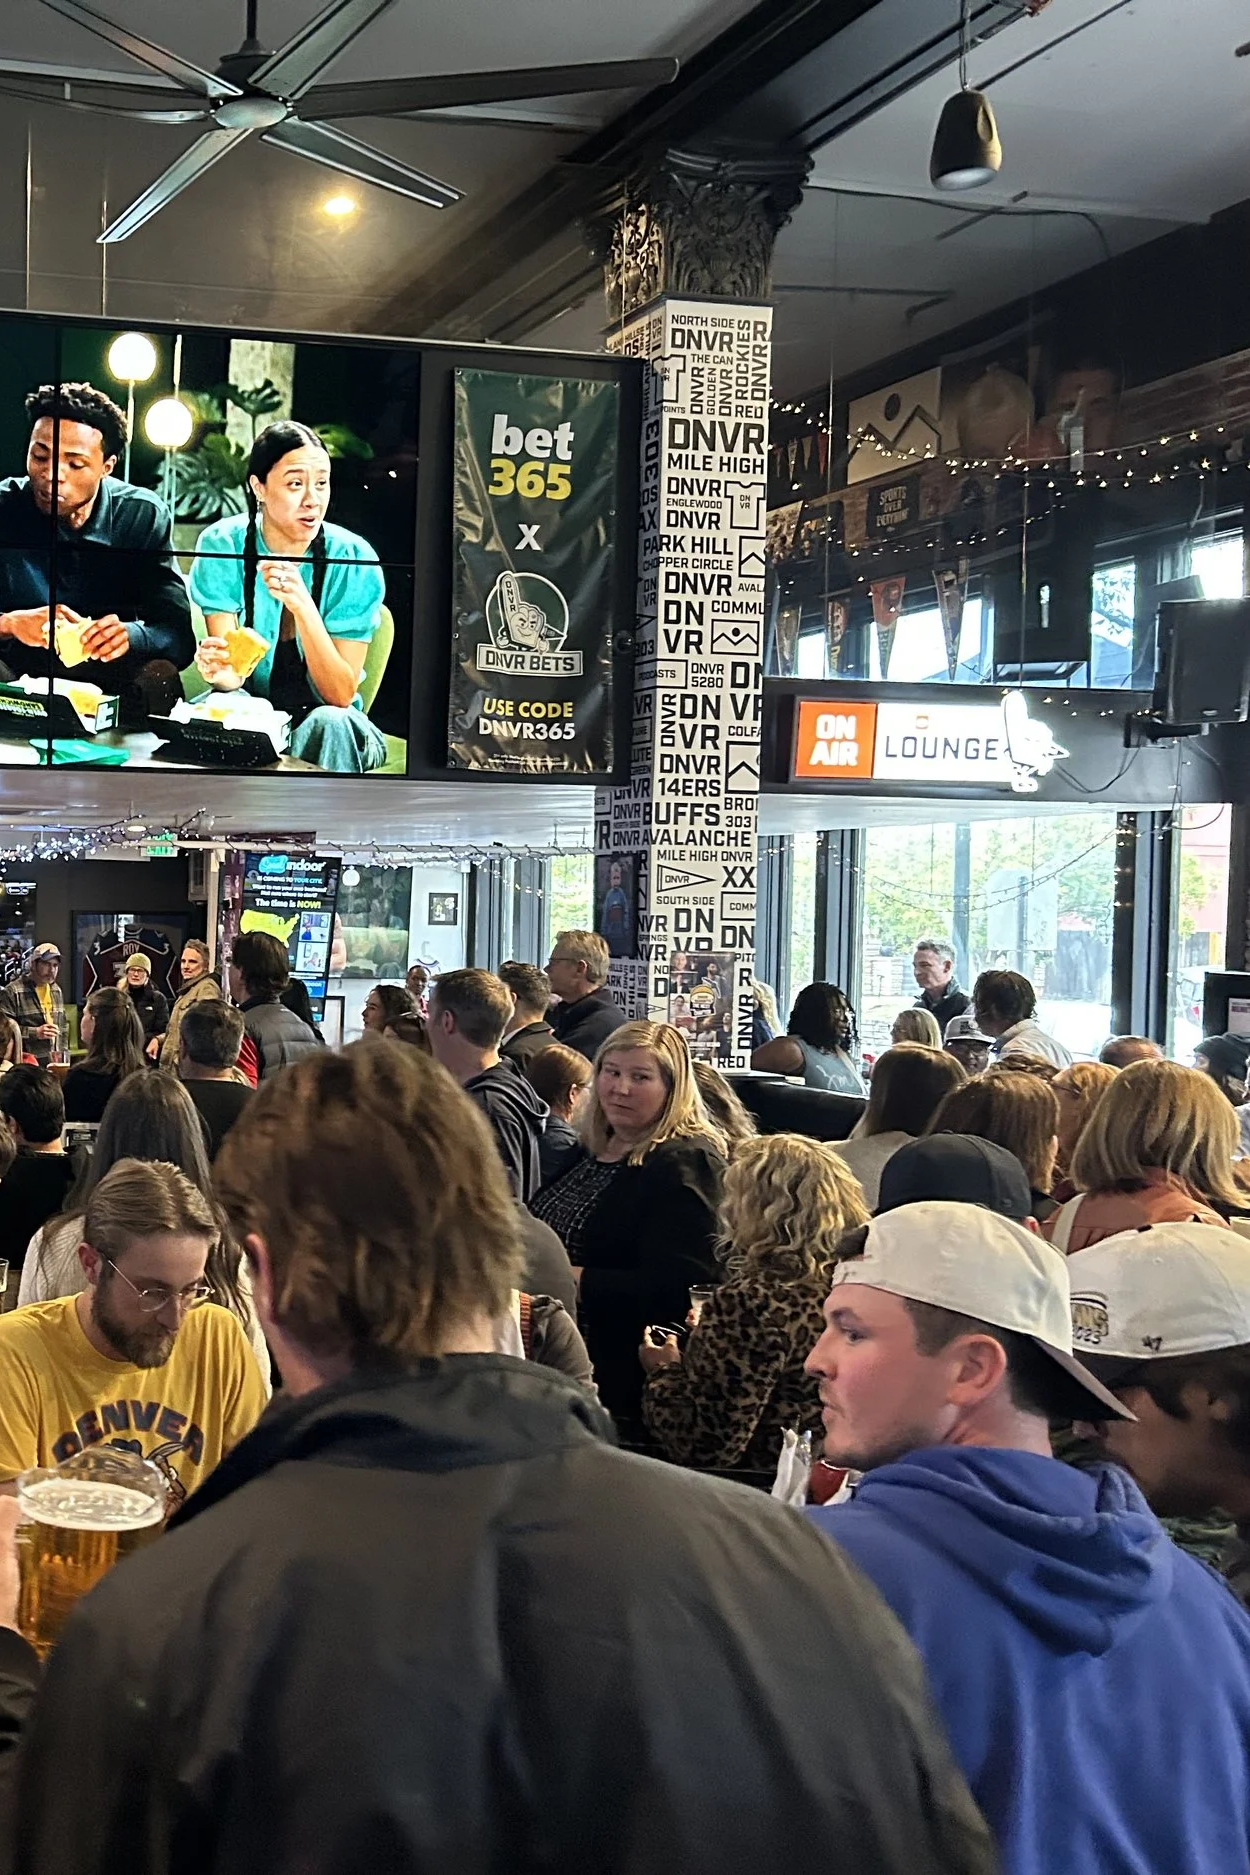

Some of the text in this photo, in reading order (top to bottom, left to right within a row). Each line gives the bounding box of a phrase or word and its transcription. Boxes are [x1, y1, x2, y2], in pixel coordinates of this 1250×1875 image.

[671, 314, 735, 328] NORTH SIDE
[671, 328, 733, 352] DNVR
[691, 353, 733, 365] THE CAN
[735, 319, 750, 400] ROCKIES
[750, 344, 767, 401] DNVR
[690, 366, 704, 415] DNVR
[707, 367, 716, 415] GOLDEN
[719, 368, 733, 416] DNVR
[735, 405, 763, 419] RED
[491, 414, 574, 460] bet
[668, 418, 765, 455] DNVR
[667, 453, 764, 474] MILE HIGH
[488, 458, 572, 500] 365
[667, 477, 721, 497] DNVR
[666, 498, 722, 509] ENGLEWOOD
[666, 509, 720, 530] DNVR
[691, 536, 733, 555] HILL
[692, 559, 733, 571] CIRCLE
[664, 571, 732, 596] DNVR
[505, 580, 517, 612] DNVR
[664, 599, 704, 625] DN
[663, 629, 703, 654] VR
[486, 650, 575, 671] DNVR BETS
[691, 663, 724, 675] DNVR
[691, 676, 723, 688] 5280
[483, 697, 573, 718] USE CODE
[680, 693, 721, 720] DN
[479, 718, 575, 740] DNVR365
[661, 694, 676, 747] DNVR
[815, 714, 856, 740] ON
[679, 723, 720, 750] VR
[809, 740, 859, 766] AIR
[885, 736, 999, 760] LOUNGE
[660, 754, 720, 775] DNVR
[658, 778, 721, 797] 14ERS
[643, 802, 720, 826] BUFFS
[725, 815, 751, 828] 303
[642, 829, 751, 847] AVALANCHE
[657, 850, 717, 862] MILE HIGH
[255, 898, 270, 907] The
[297, 900, 321, 909] NOW!
[656, 896, 715, 905] SOUTH SIDE
[674, 908, 714, 933] DN
[122, 943, 140, 957] ROY
[717, 1056, 745, 1068] RED
[52, 1399, 205, 1466] DENVER
